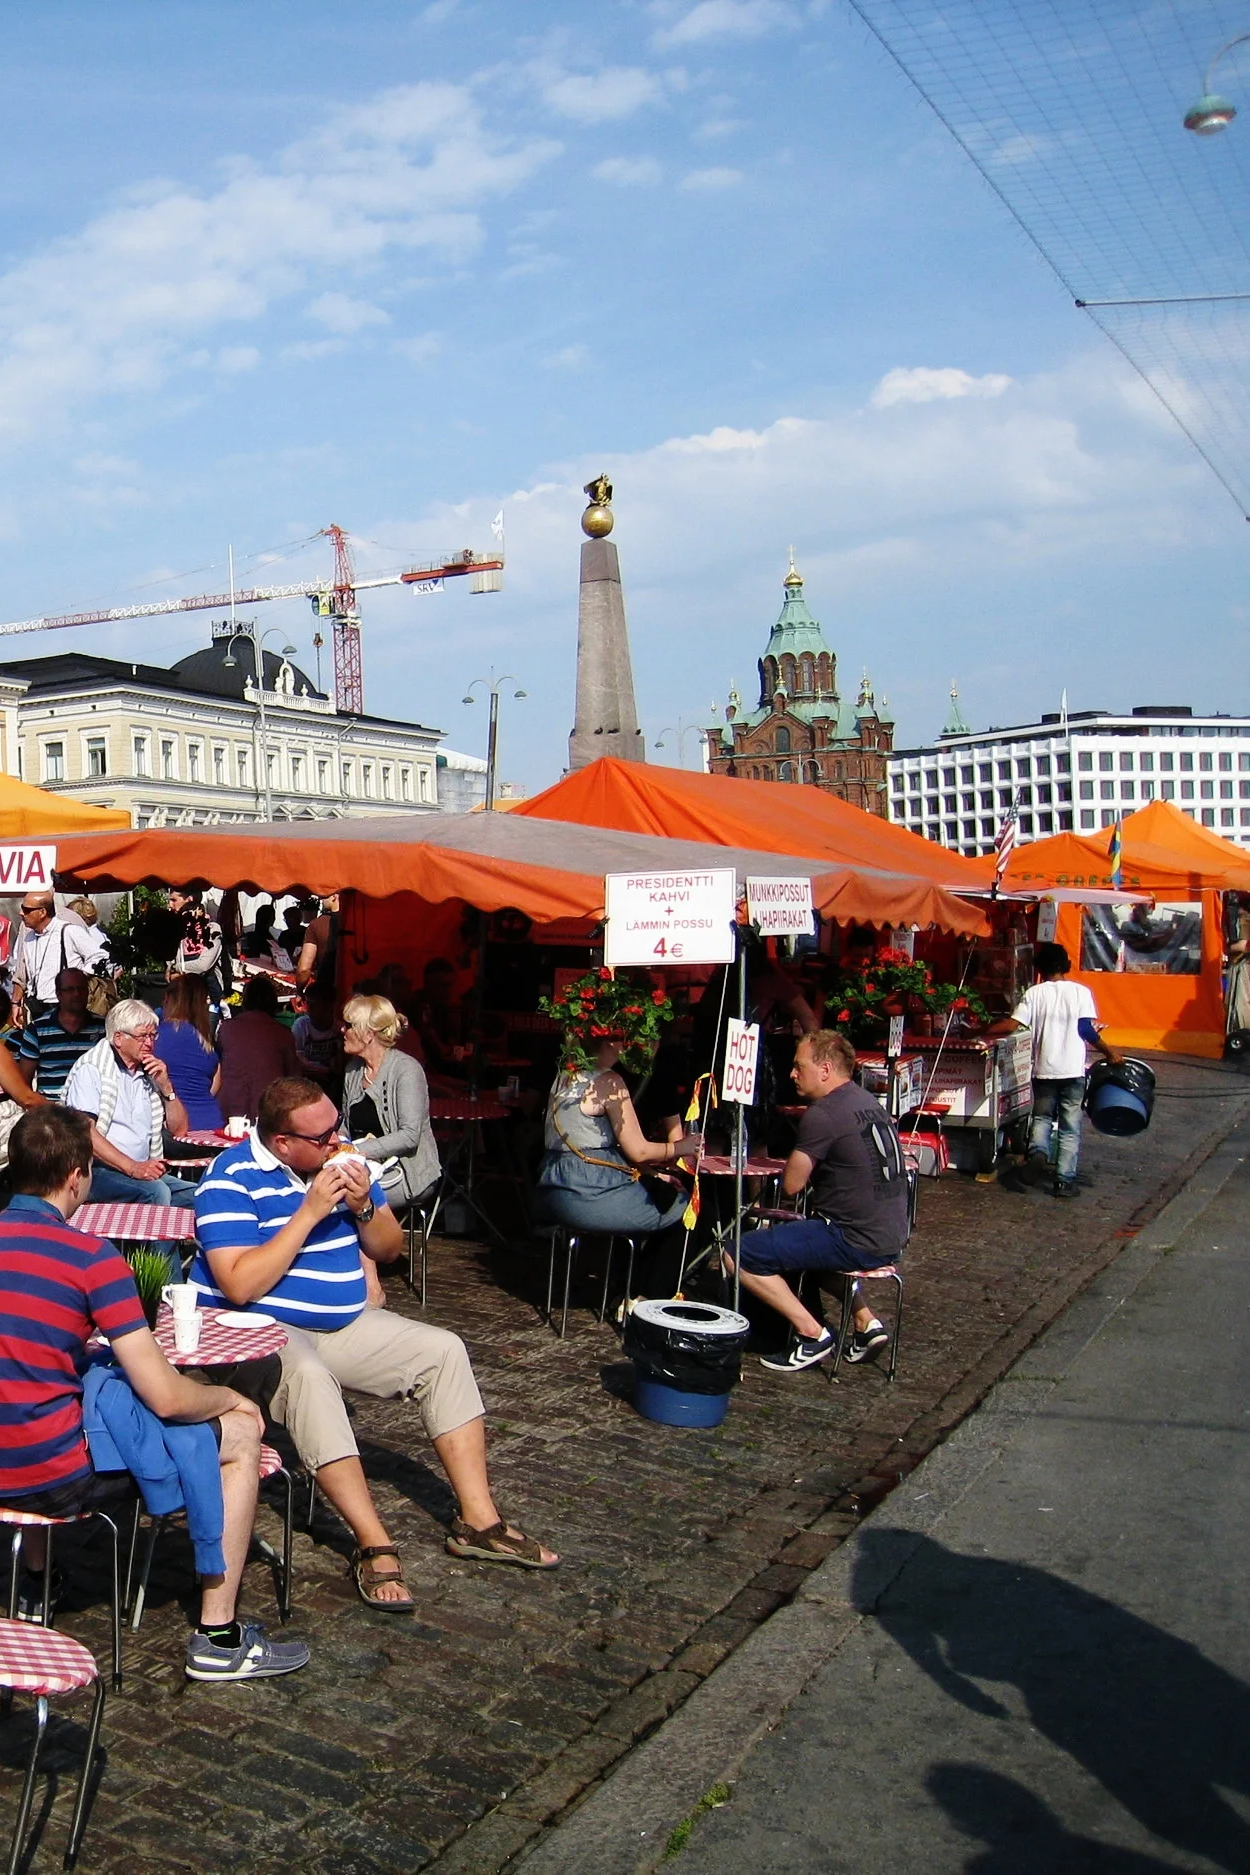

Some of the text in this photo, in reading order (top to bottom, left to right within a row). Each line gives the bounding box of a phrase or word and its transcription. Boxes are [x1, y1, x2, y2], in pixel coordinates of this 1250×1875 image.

[417, 581, 437, 594] SRV
[627, 876, 714, 890] PRESIDENTTI
[649, 891, 690, 902] KAHVI
[749, 884, 810, 903] MUNKKIPOSSUT
[626, 918, 713, 931] LÄMMIN POSSU
[730, 1031, 756, 1062] HOT
[726, 1063, 753, 1095] DOG
